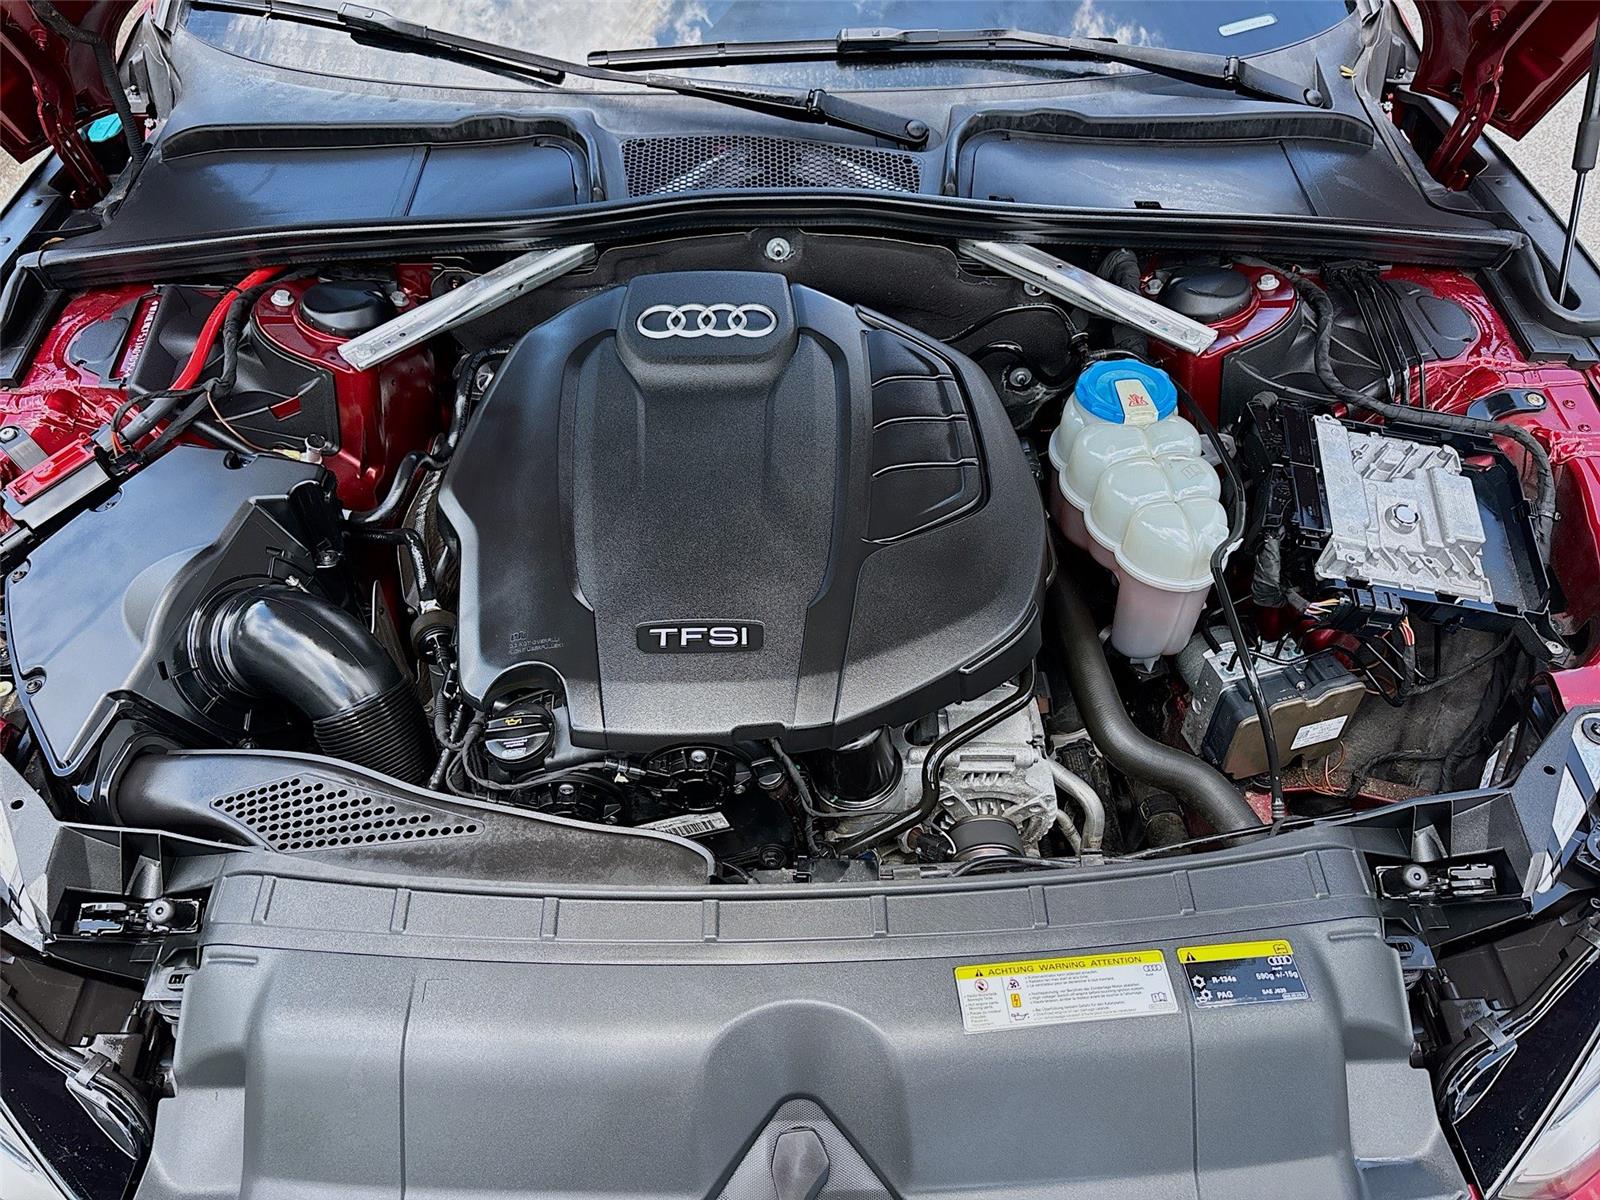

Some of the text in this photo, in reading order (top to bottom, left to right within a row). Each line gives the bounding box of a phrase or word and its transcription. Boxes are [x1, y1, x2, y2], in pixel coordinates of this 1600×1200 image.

[649, 626, 749, 649] TFSI
[988, 955, 1142, 976] ACHTUNG WARNING ATTENTION
[1216, 990, 1234, 999] PAG
